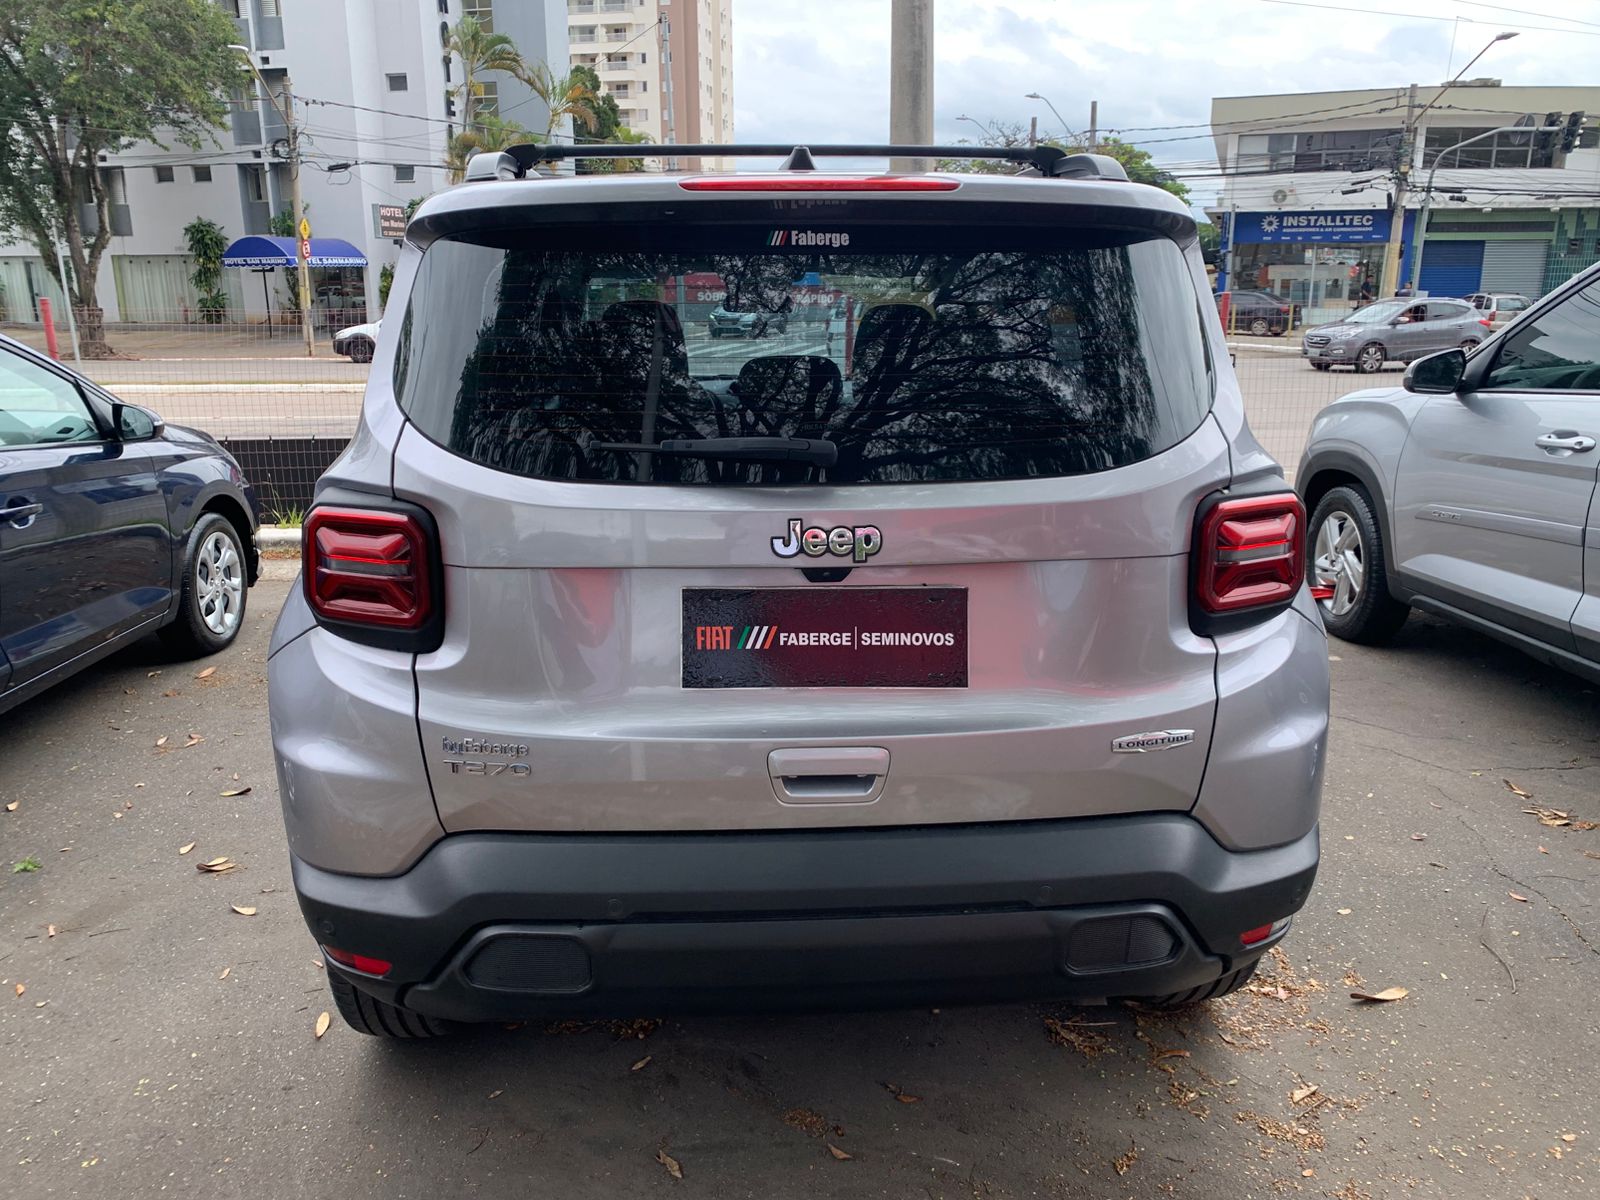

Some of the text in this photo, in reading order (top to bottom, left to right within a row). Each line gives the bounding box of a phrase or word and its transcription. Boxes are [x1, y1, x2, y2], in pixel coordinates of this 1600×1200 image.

[380, 206, 404, 217] HOTEL
[1282, 215, 1374, 227] INSTALLTEC
[791, 230, 850, 248] Faberge
[771, 518, 882, 563] Jeep
[696, 625, 955, 650] FIAT FABERGE SEMINOVOS
[1118, 734, 1191, 749] LONGITUDE
[443, 759, 532, 776] T270
